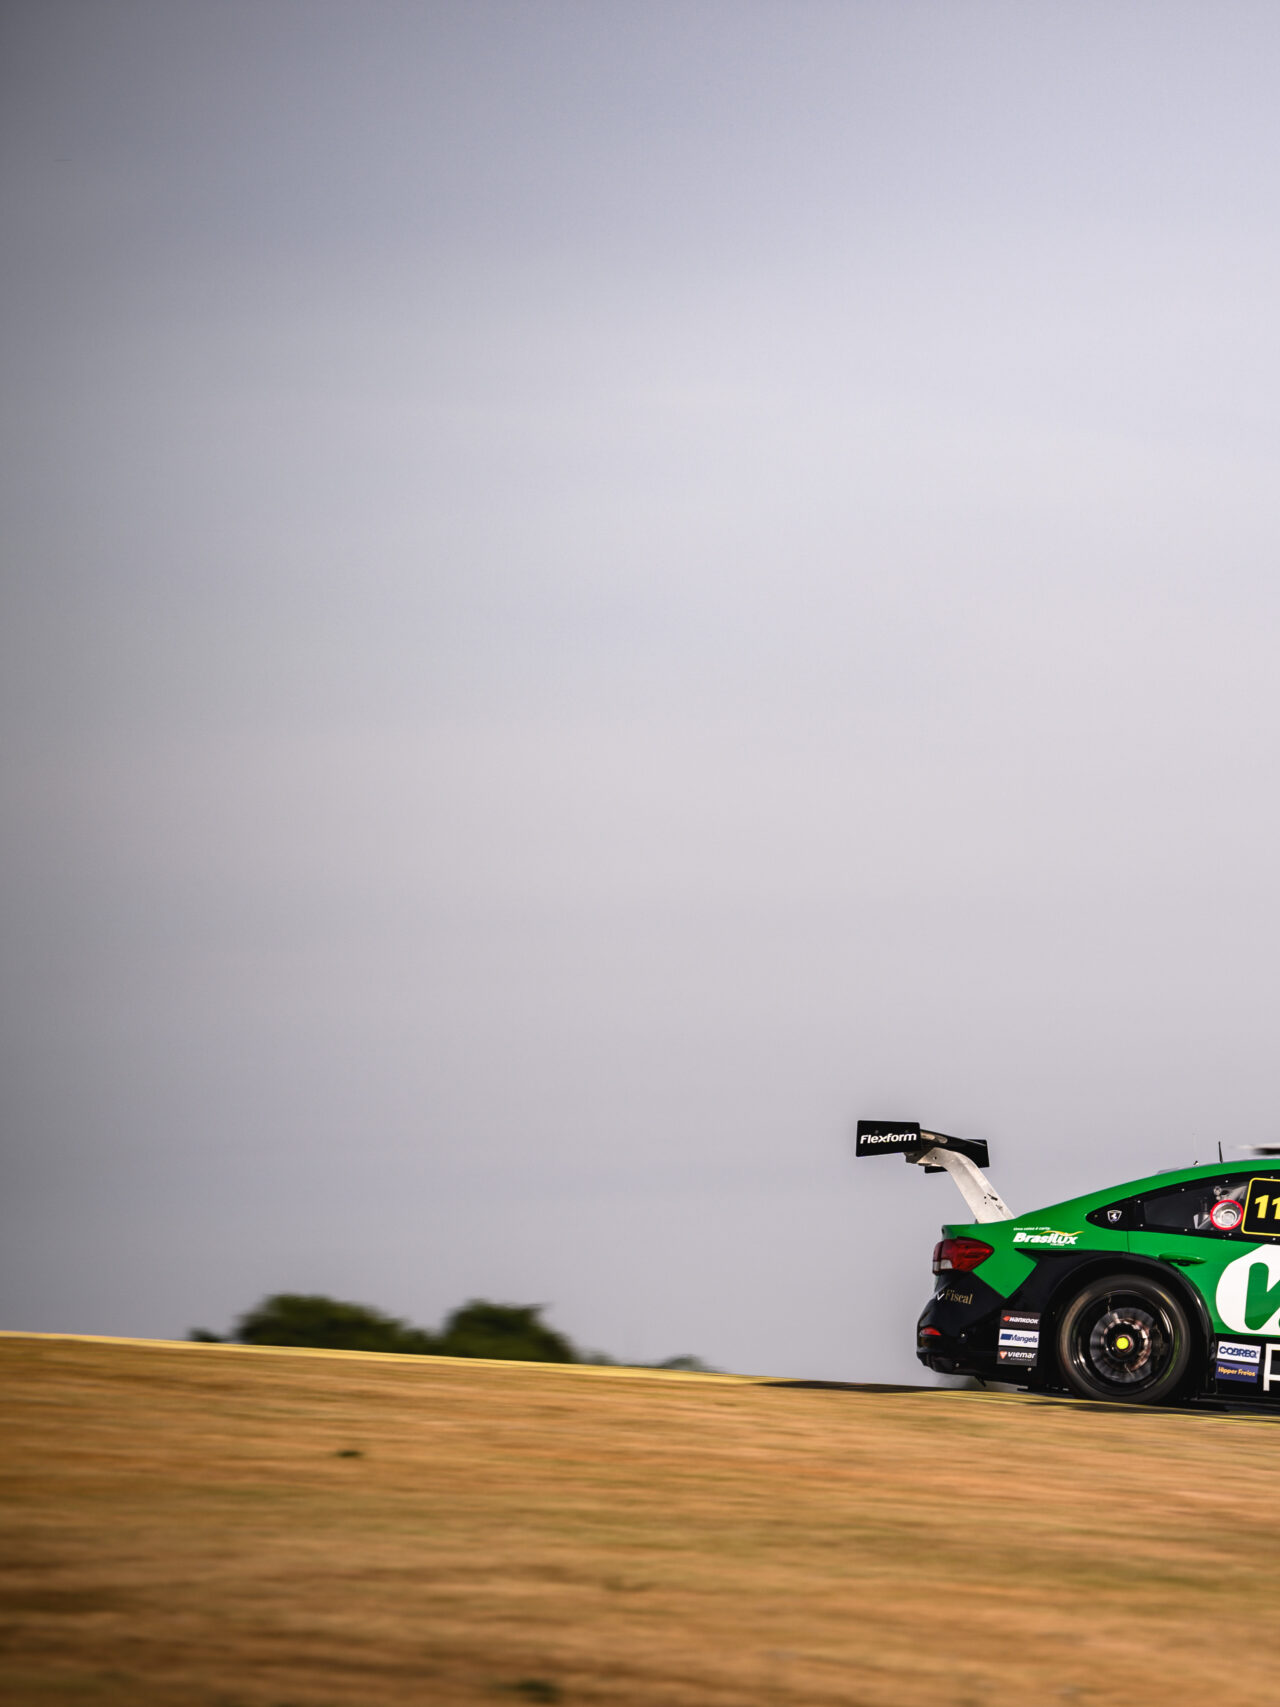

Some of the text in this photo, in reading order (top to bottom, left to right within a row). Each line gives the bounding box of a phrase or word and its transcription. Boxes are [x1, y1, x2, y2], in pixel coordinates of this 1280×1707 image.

[860, 1133, 917, 1144] Flexform
[1013, 1232, 1078, 1245] Brasilux
[945, 1289, 974, 1305] Fiscal
[1010, 1334, 1038, 1344] Mangels
[1218, 1366, 1256, 1377] Hipper Freios
